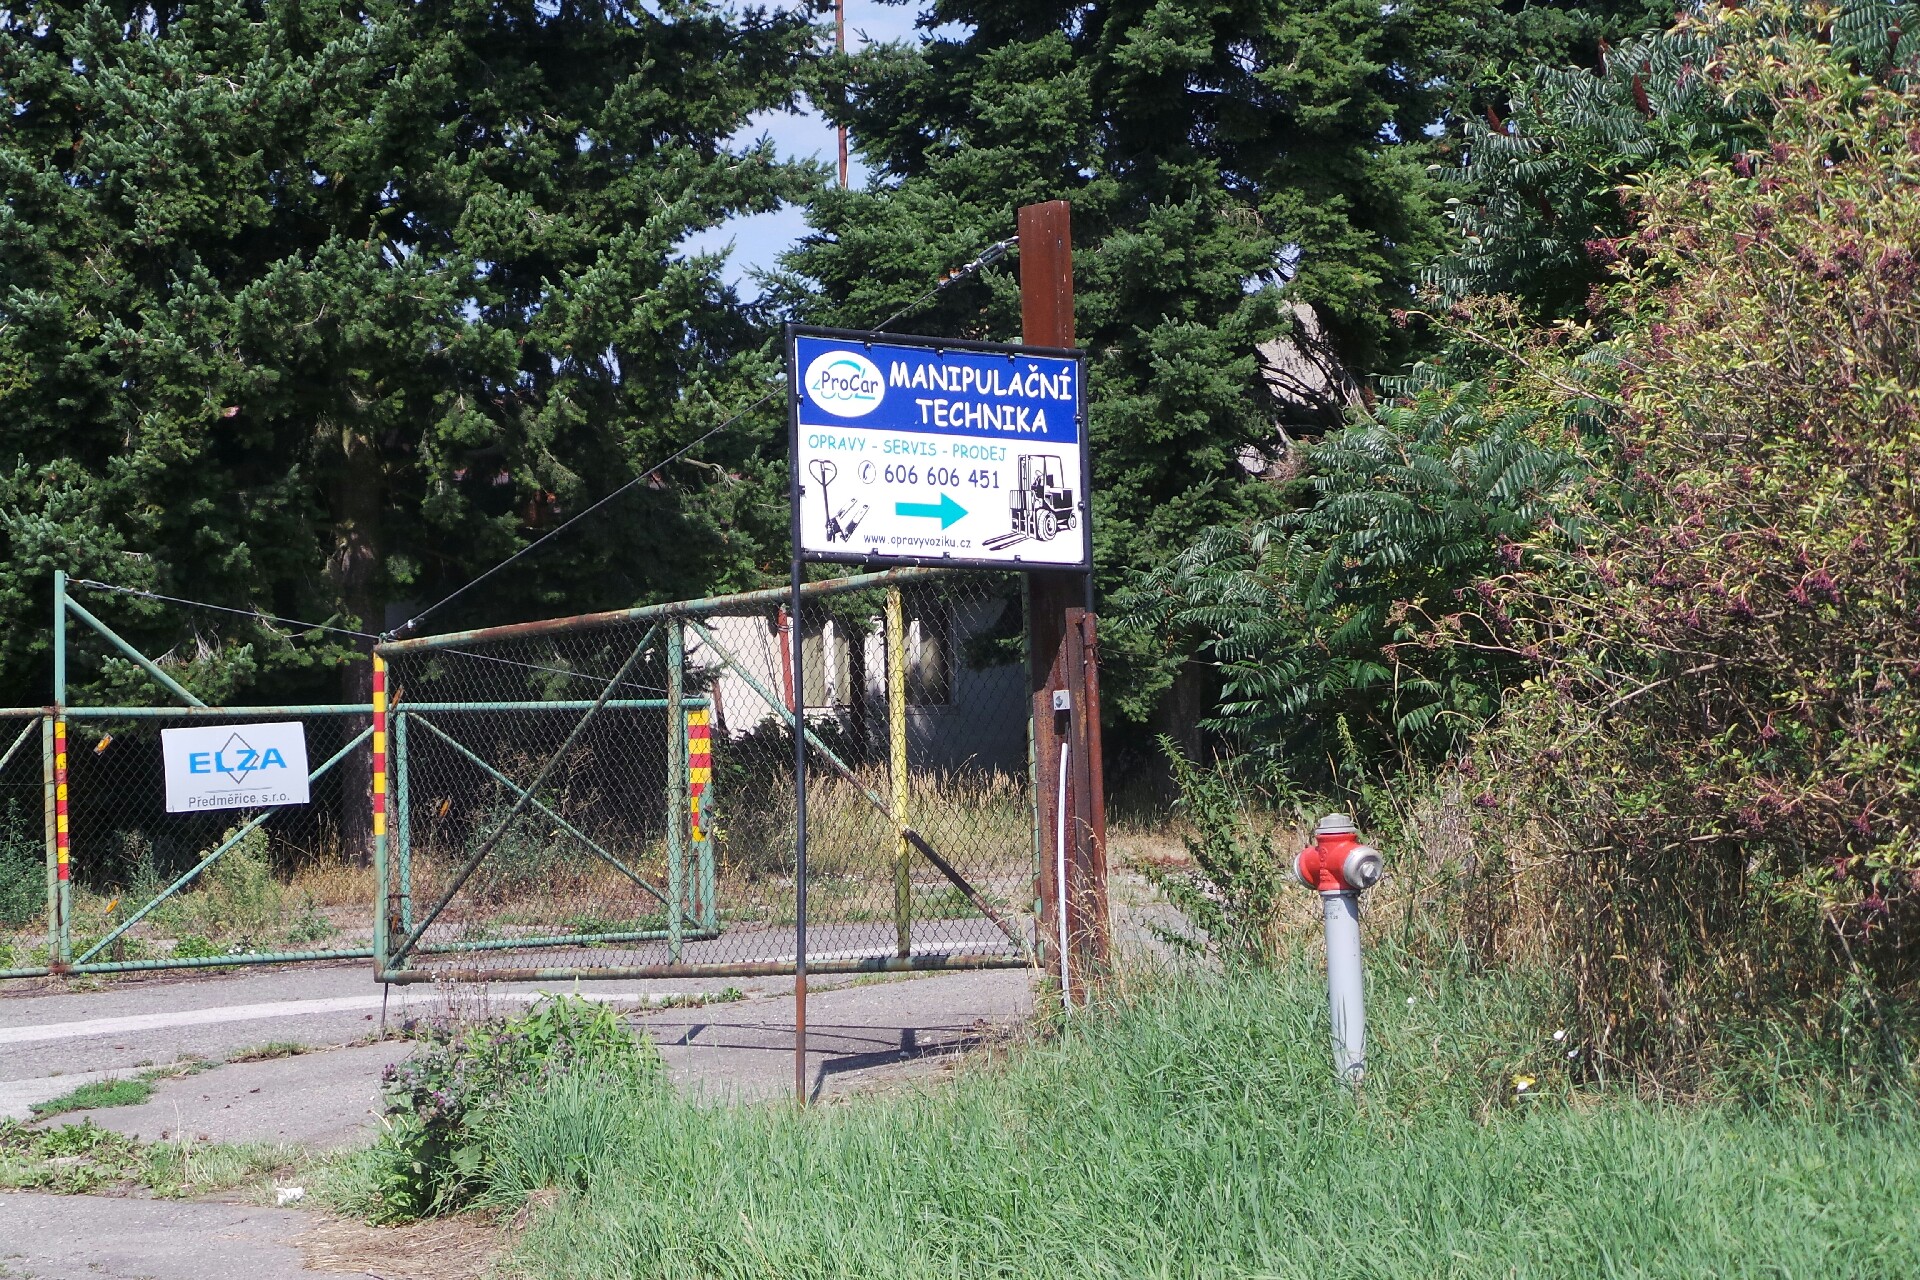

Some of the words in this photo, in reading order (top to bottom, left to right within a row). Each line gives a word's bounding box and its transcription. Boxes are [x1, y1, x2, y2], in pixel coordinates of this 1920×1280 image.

[821, 370, 878, 394] ProCar
[889, 361, 1072, 400] MANIPULAČNÍ
[915, 398, 1048, 434] TECHNIKA
[808, 434, 866, 452] OPRAVY
[883, 439, 937, 457] SERVIS
[952, 445, 1007, 462] PRODEJ
[884, 464, 918, 484] 606
[926, 467, 960, 487] 606
[967, 470, 1000, 489] 451
[863, 534, 971, 549] www.opravyvoziku.cz
[189, 748, 287, 774] ELZA
[261, 792, 290, 803] s.r.o.
